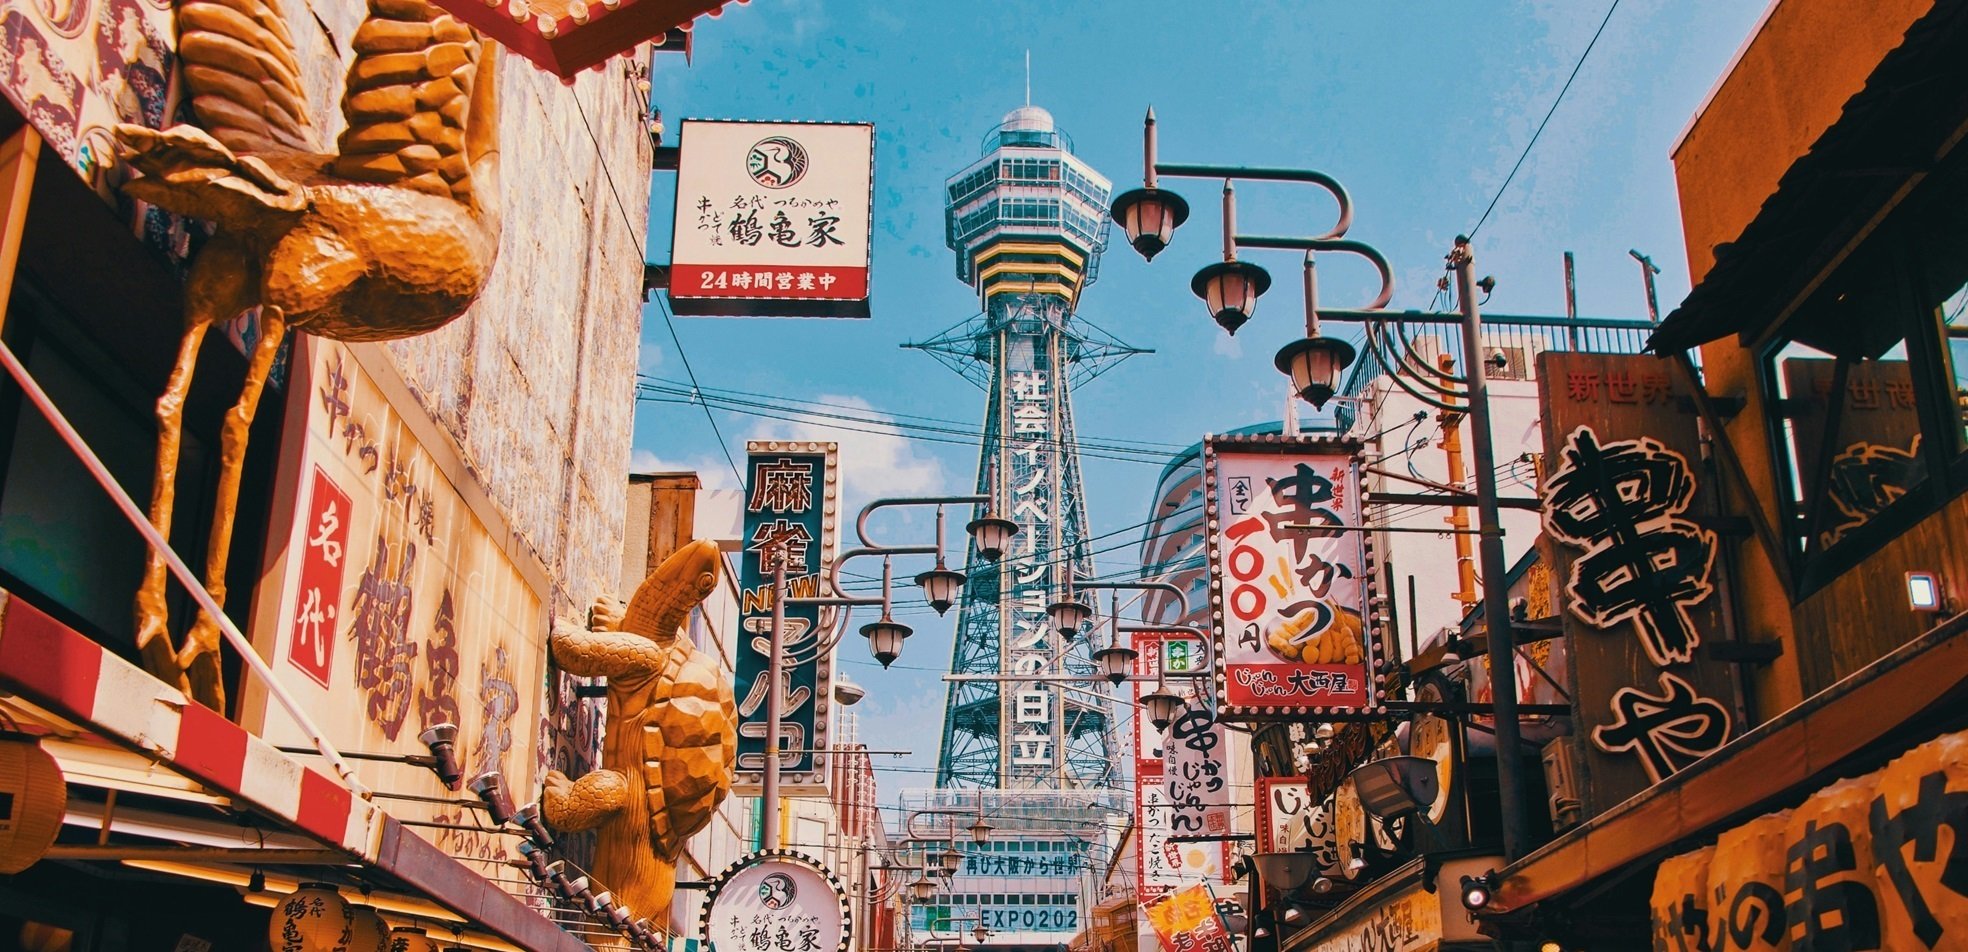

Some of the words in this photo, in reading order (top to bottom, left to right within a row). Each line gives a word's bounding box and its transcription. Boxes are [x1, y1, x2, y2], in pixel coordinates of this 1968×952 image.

[727, 208, 845, 248] 鶴亀家
[700, 270, 837, 291] 24時間営業中
[1568, 368, 1672, 404] 新世界
[1231, 479, 1249, 512] 全て
[747, 458, 814, 575] 麻雀
[1261, 462, 1353, 646] 串かつ
[297, 500, 342, 667] 名代
